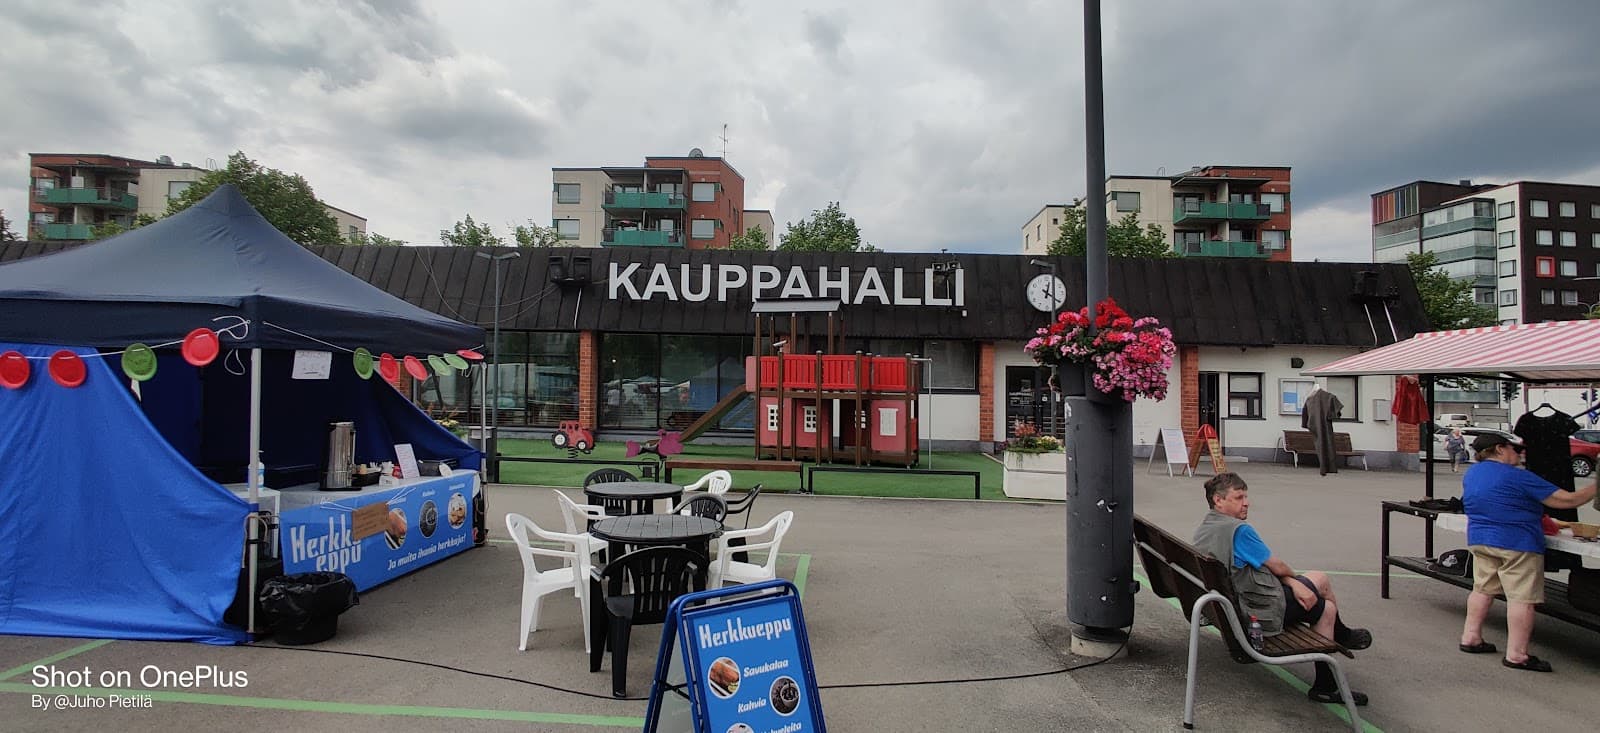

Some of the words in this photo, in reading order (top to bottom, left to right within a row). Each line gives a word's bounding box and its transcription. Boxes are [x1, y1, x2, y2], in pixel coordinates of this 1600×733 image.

[608, 262, 965, 307] KAUPPAHALLI
[290, 513, 361, 563] Herkk
[388, 559, 397, 571] Ja
[398, 552, 417, 567] muita
[698, 616, 792, 649] Herkkueppu
[743, 659, 789, 678] Savukalaa
[737, 697, 767, 713] Kahvia
